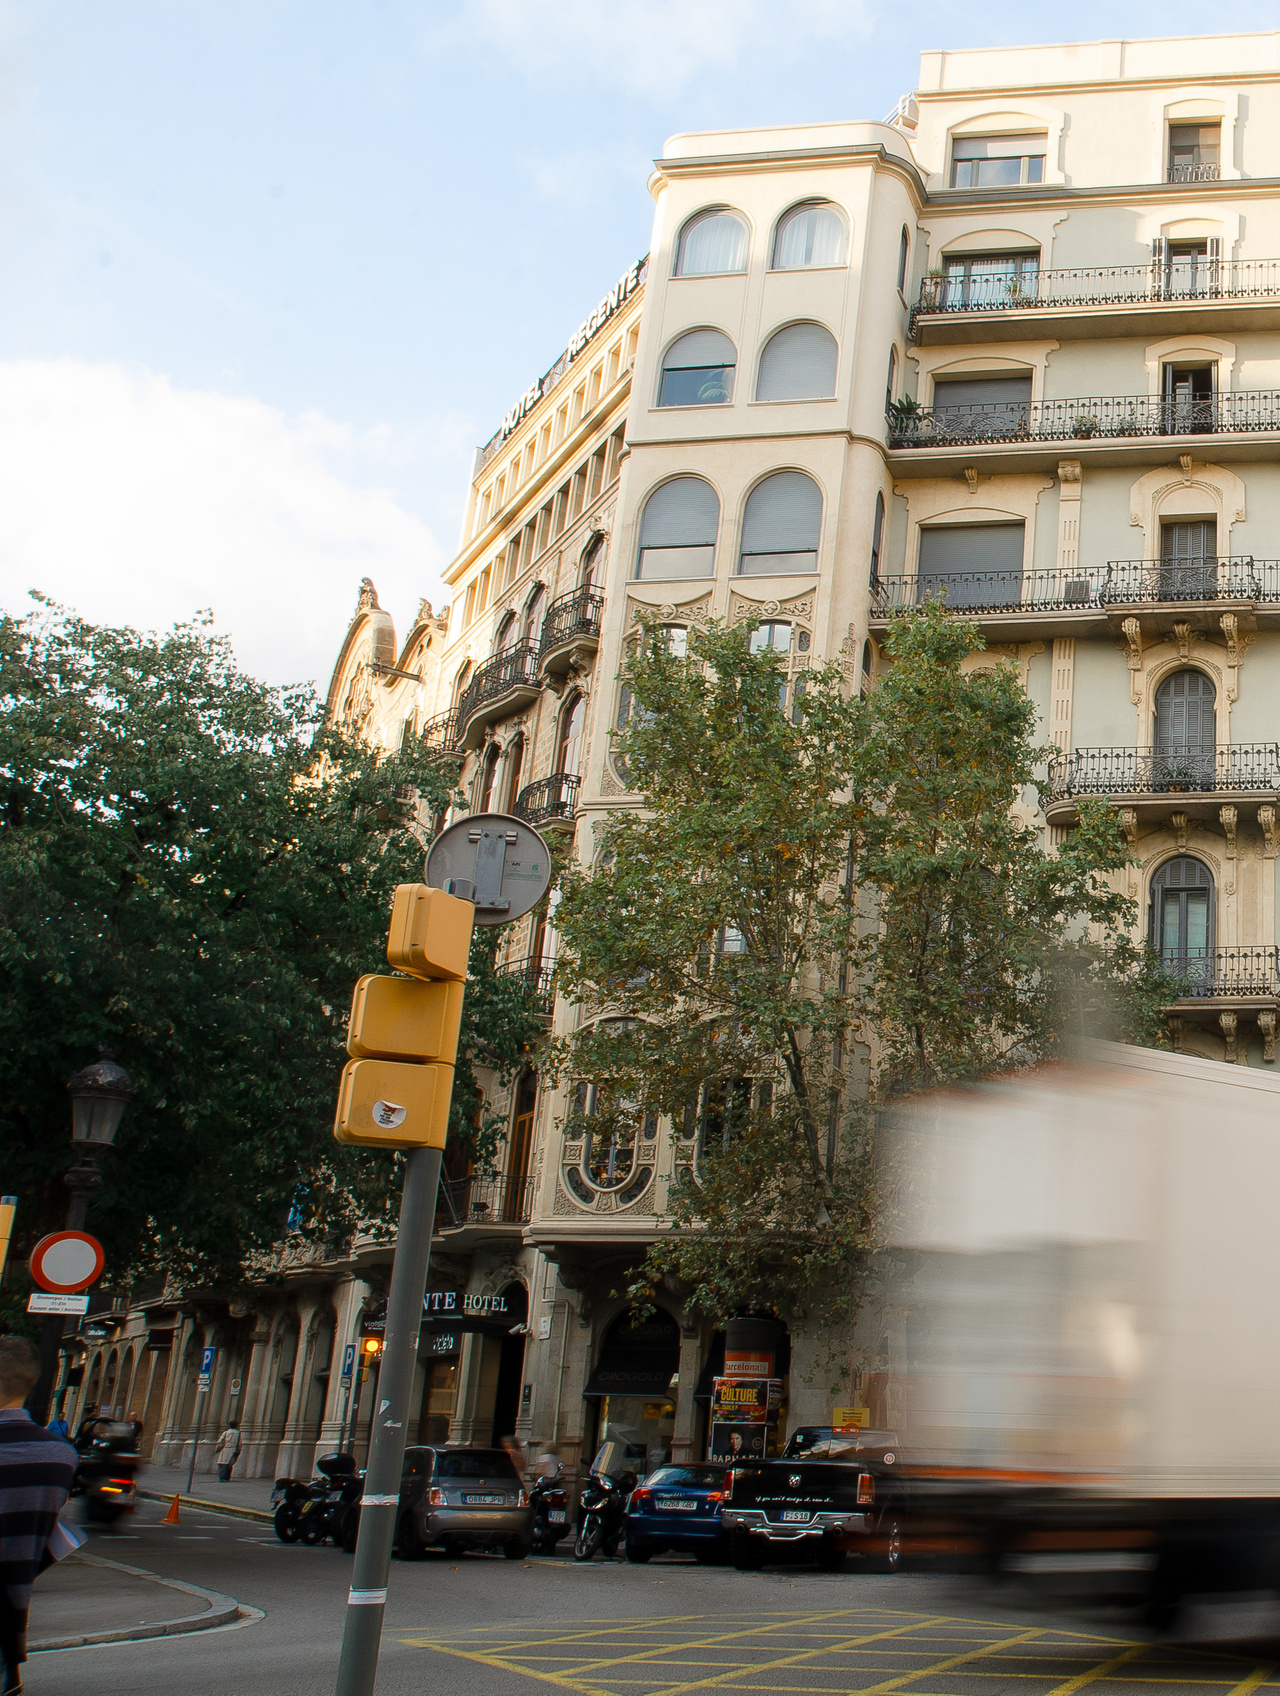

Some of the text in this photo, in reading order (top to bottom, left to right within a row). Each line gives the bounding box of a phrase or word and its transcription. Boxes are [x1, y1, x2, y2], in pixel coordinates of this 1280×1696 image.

[500, 259, 641, 440] HOTEL REGENTE
[463, 1294, 508, 1312] HOTEL
[202, 1350, 211, 1370] P
[344, 1348, 354, 1373] P
[720, 1387, 758, 1402] CULTURE
